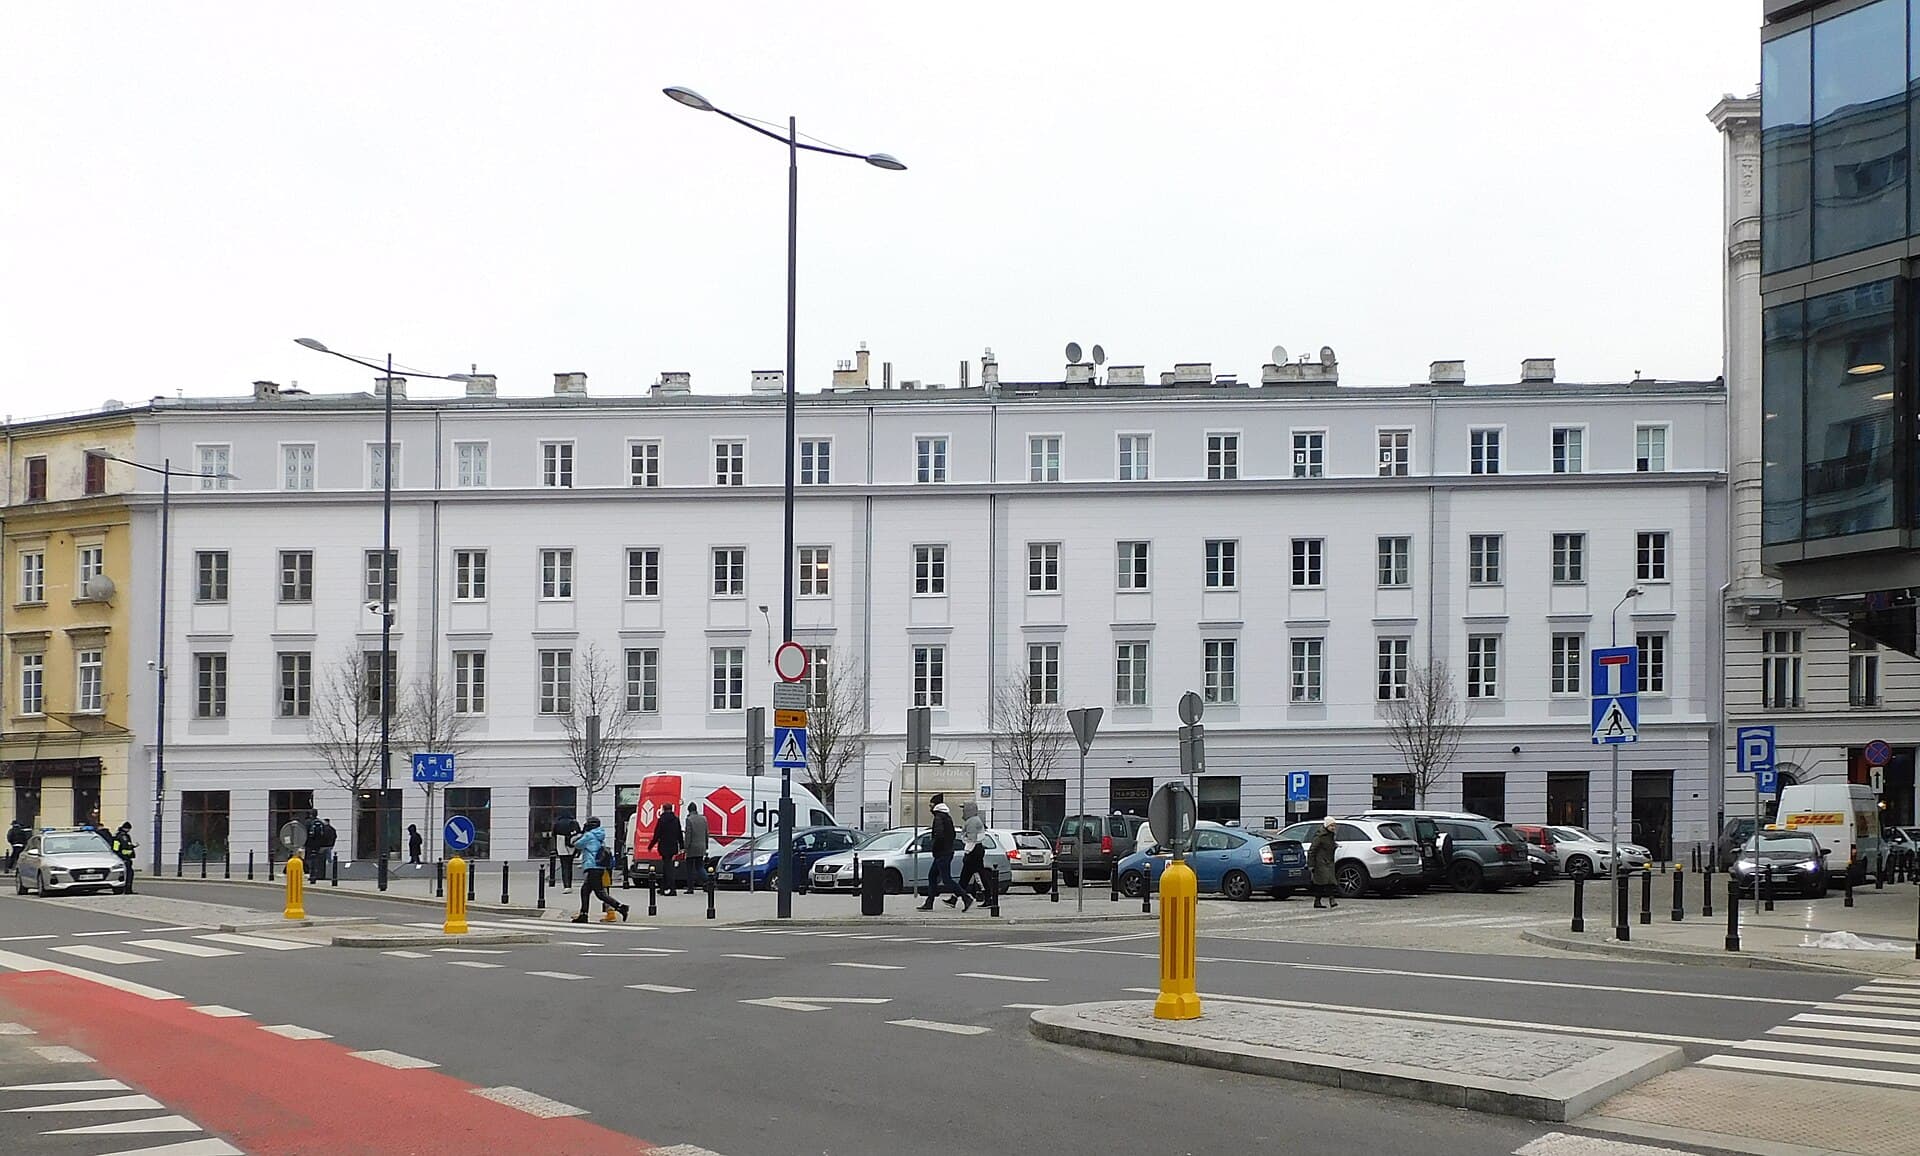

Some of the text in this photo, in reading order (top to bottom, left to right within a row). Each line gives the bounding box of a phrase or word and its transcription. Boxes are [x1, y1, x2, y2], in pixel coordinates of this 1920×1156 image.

[1743, 738, 1768, 771] P
[1293, 773, 1305, 793] P
[1762, 772, 1773, 786] P
[1794, 814, 1836, 824] DHL
